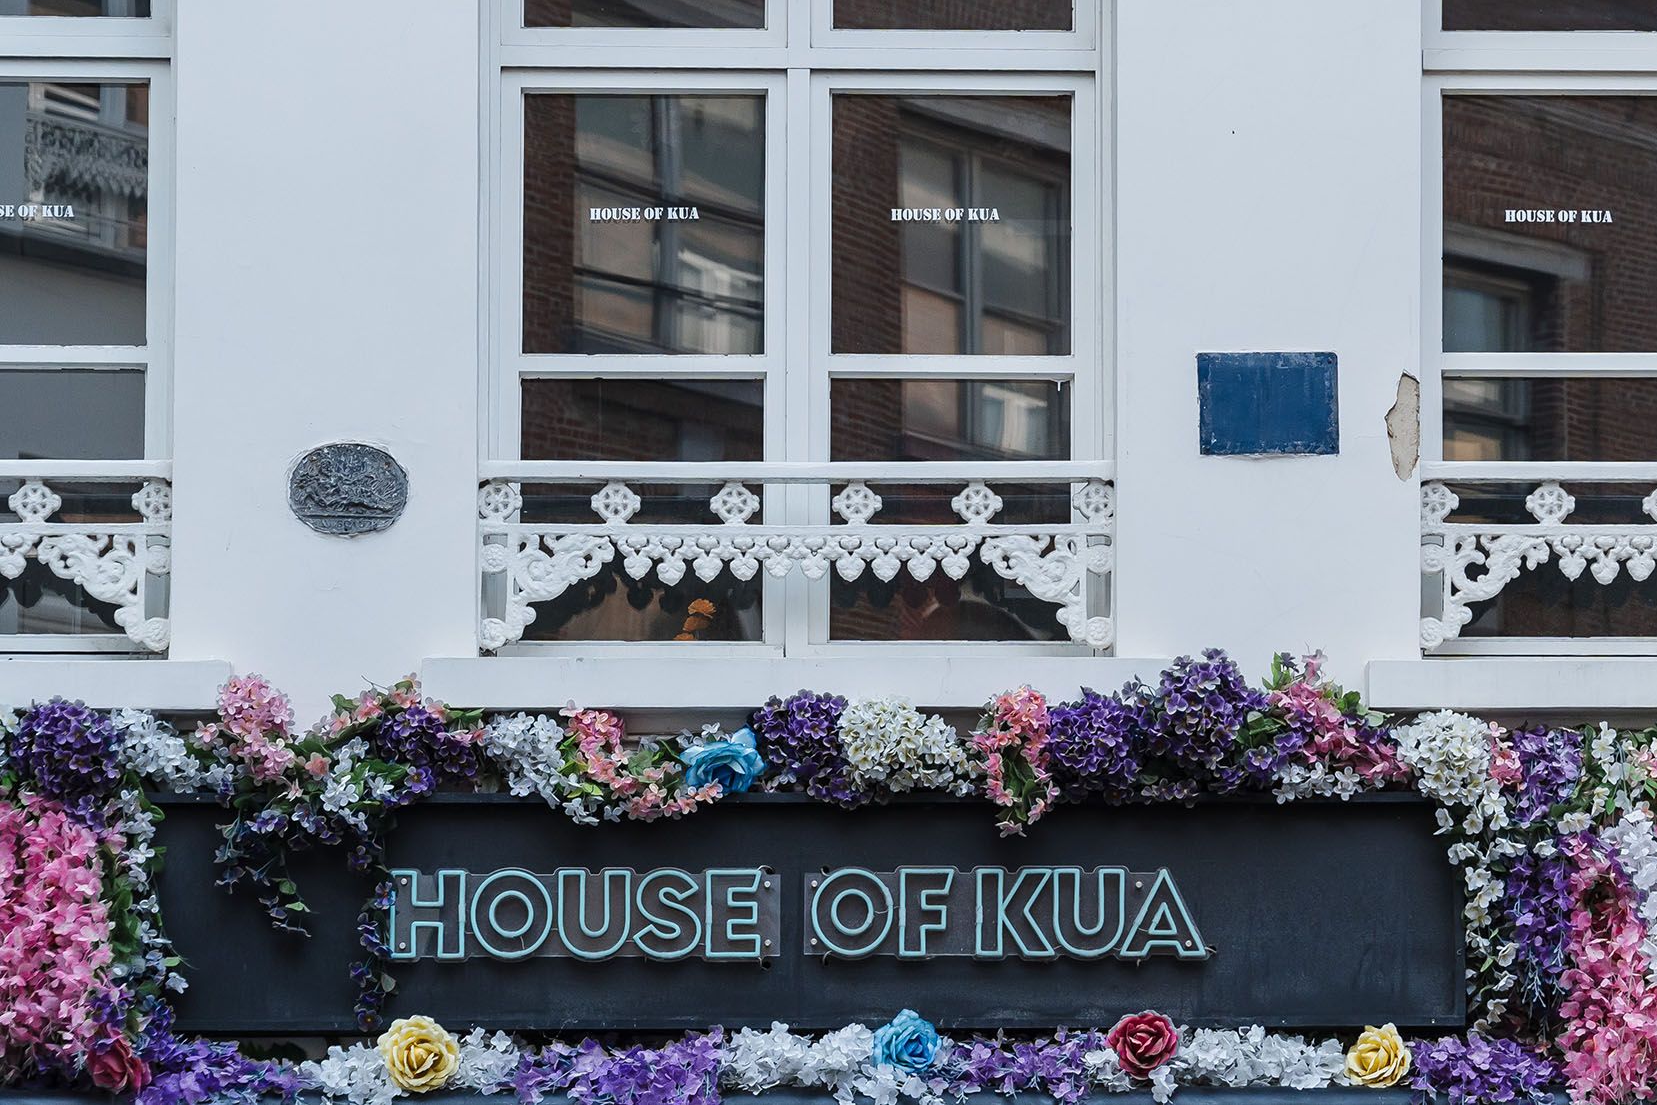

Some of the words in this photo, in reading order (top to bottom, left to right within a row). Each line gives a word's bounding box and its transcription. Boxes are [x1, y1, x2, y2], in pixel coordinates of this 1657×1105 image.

[18, 205, 38, 217] OF
[42, 205, 75, 218] KUA
[590, 208, 641, 220] HOUSE
[644, 207, 664, 220] OF
[667, 207, 700, 220] KUA
[891, 208, 941, 221] HOUSE
[944, 208, 965, 221] OF
[968, 208, 1000, 221] KUA
[1505, 210, 1555, 223] HOUSE
[1558, 210, 1577, 223] OF
[1581, 210, 1613, 223] KUA
[389, 868, 762, 958] HOUSE
[811, 868, 954, 957] OF
[975, 868, 1206, 957] KUA
